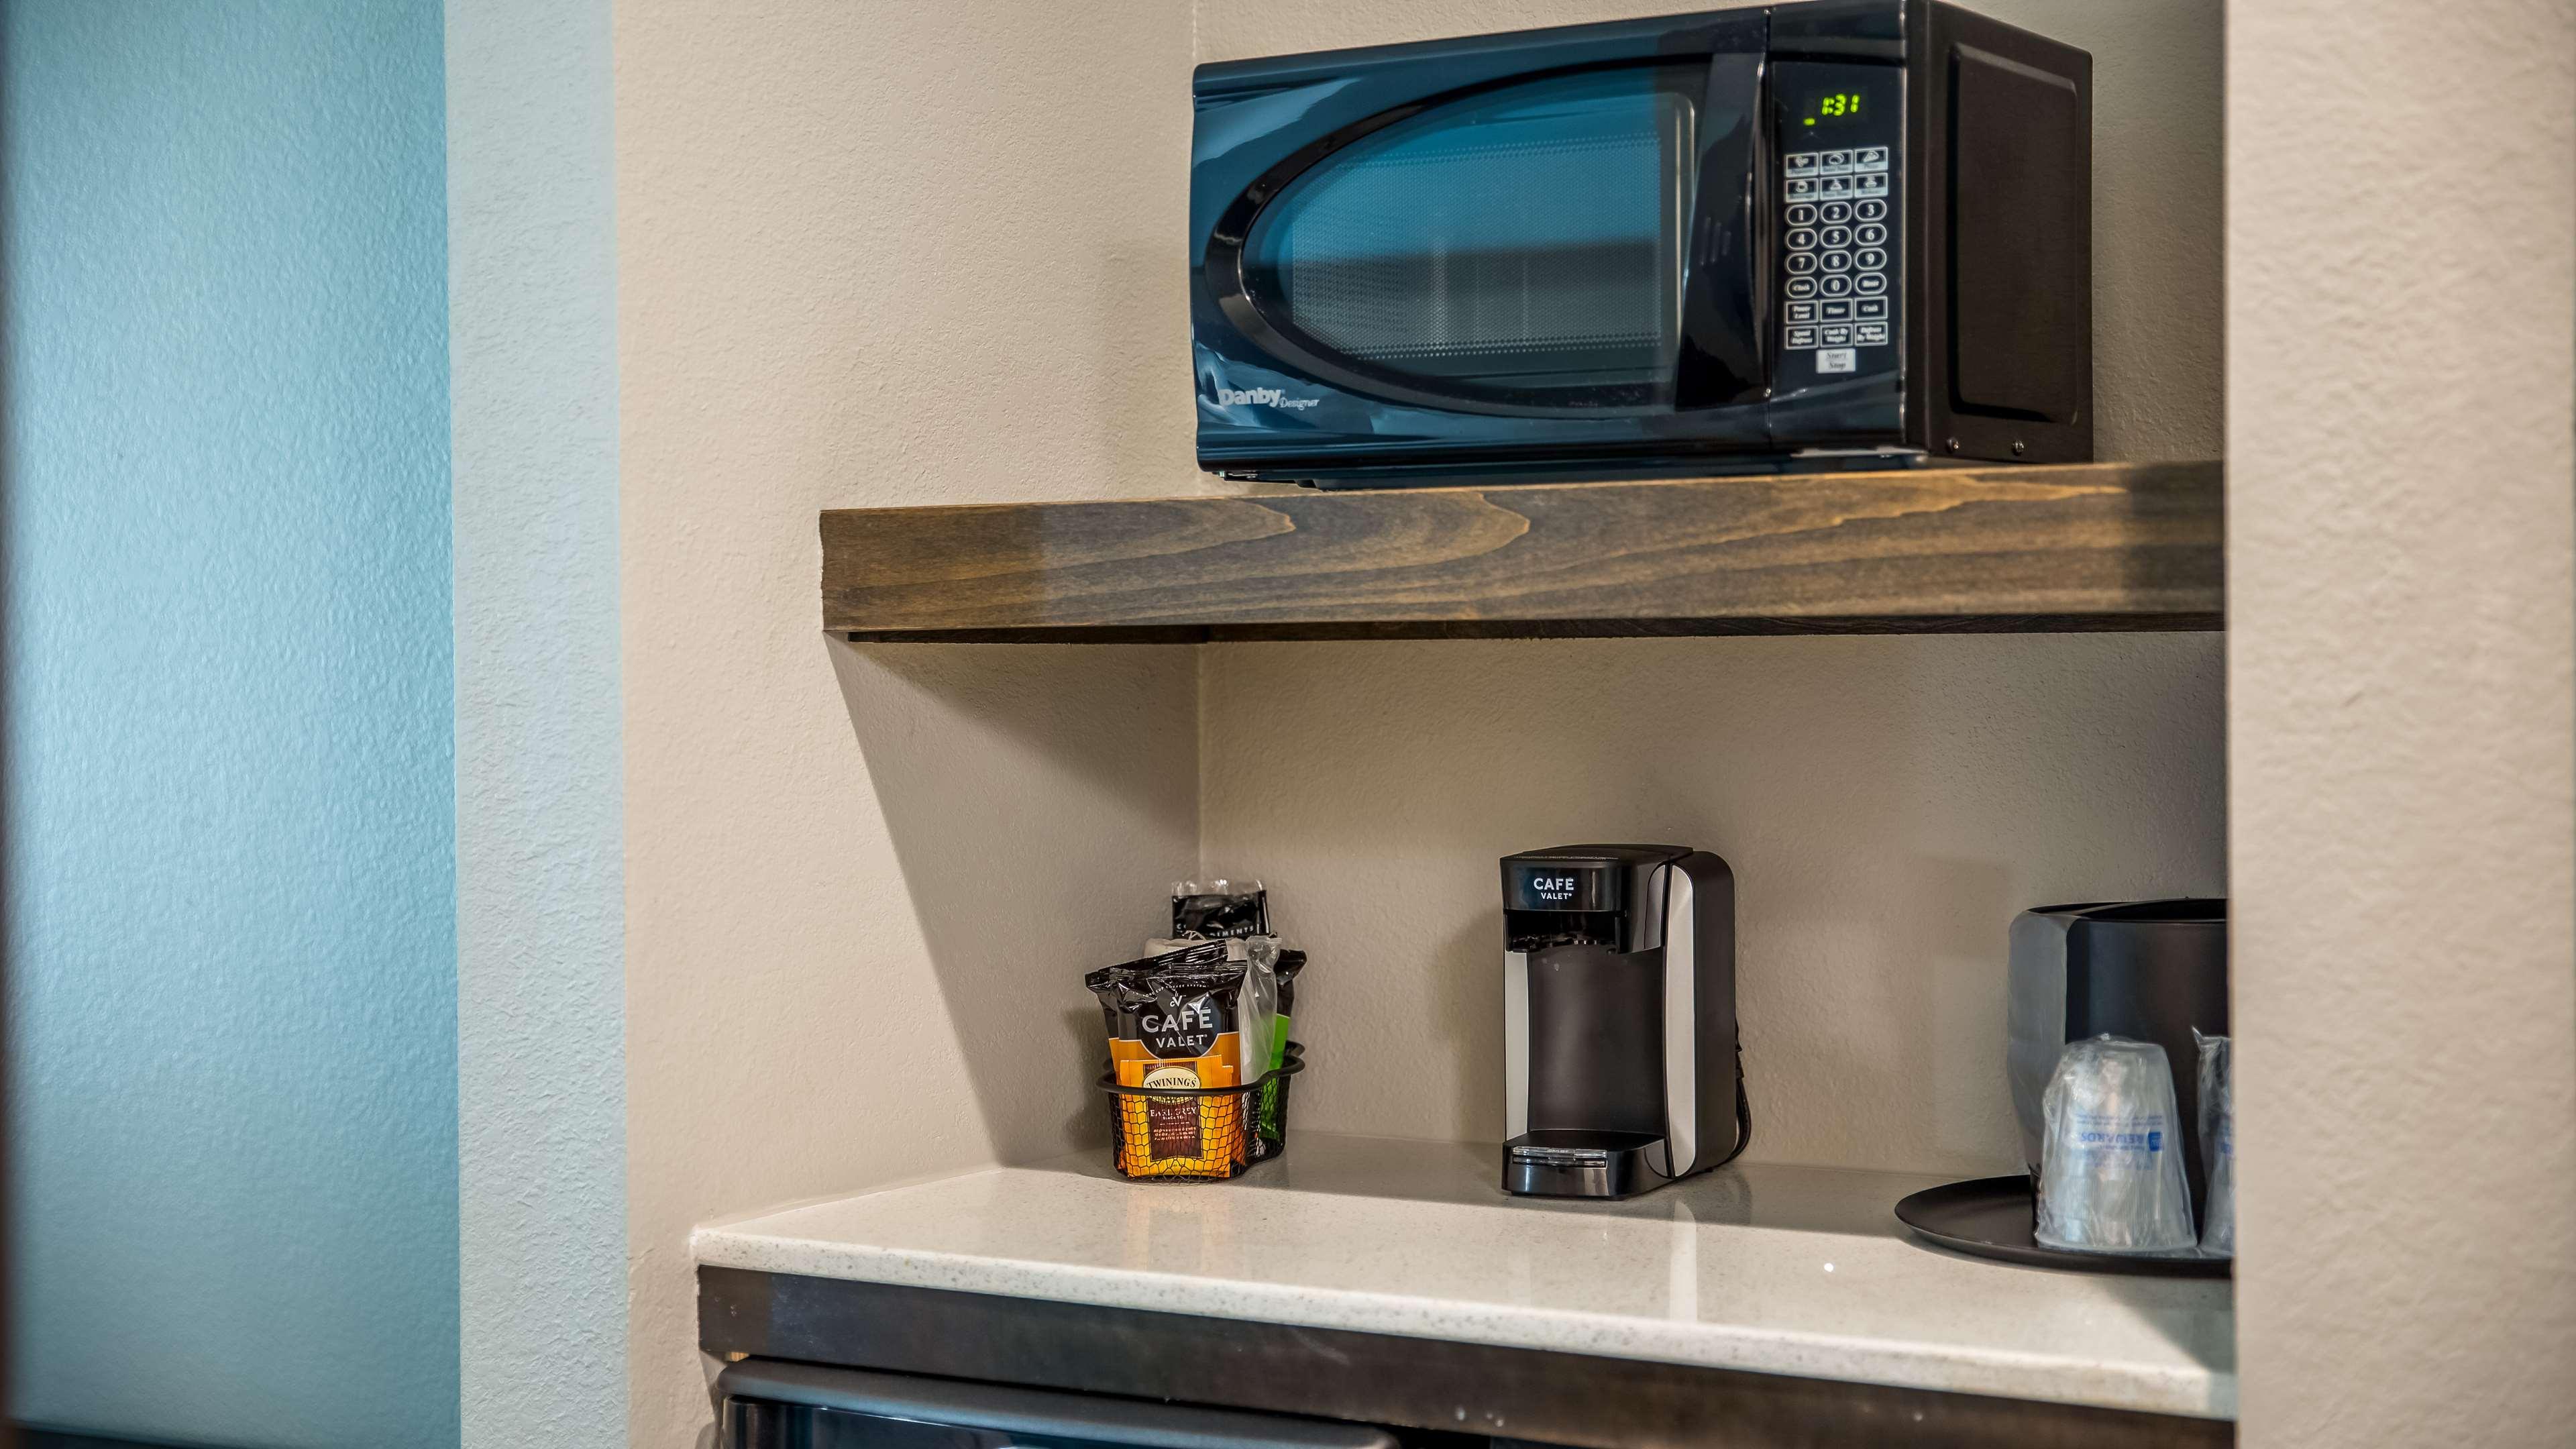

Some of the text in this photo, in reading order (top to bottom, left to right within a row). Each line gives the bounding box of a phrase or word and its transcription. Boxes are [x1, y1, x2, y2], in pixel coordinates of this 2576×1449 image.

[1822, 94, 1860, 116] 1:31
[1798, 209, 1804, 221] 1
[1831, 207, 1840, 219] 2
[1867, 204, 1874, 216] 3
[1796, 233, 1805, 245] 4
[1832, 231, 1840, 242] 5
[1866, 229, 1874, 240] 6
[1797, 257, 1805, 268] 7
[1831, 255, 1840, 267] 8
[1866, 253, 1874, 265] 9
[1831, 279, 1840, 291] 0
[1218, 387, 1320, 411] Danby Designer
[1146, 1077, 1197, 1089] TWININGS
